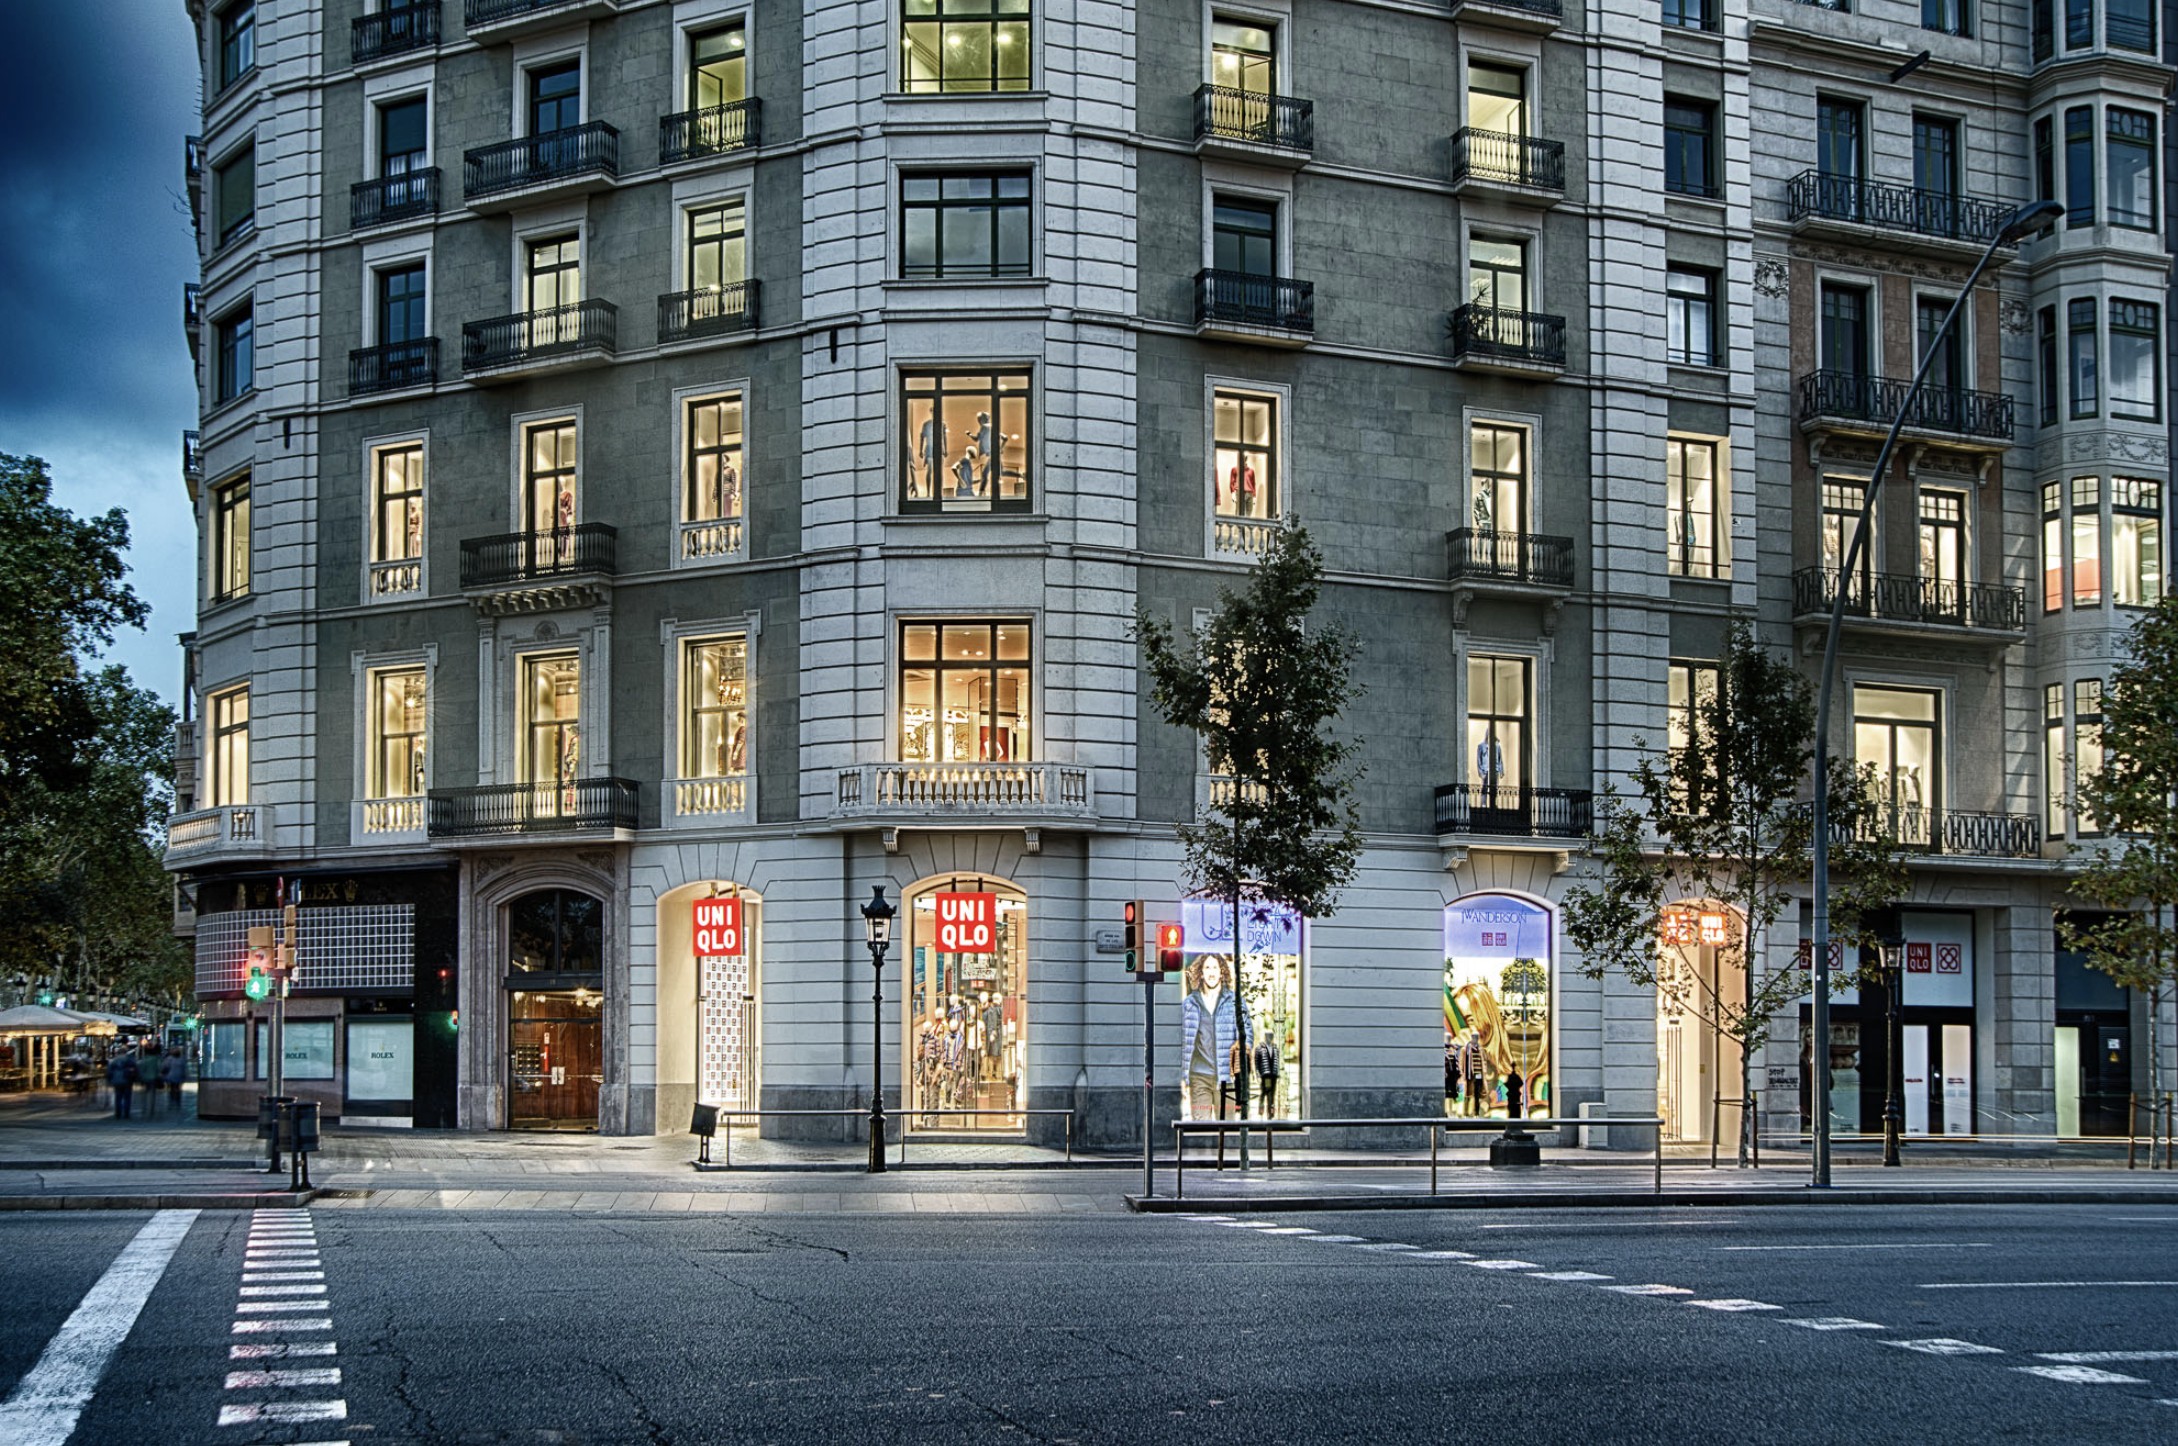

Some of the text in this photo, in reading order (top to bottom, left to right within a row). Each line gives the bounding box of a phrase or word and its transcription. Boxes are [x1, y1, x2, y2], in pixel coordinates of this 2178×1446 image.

[697, 905, 732, 926] UNI
[942, 899, 984, 921] UNI
[1701, 915, 1722, 928] UNI
[697, 929, 736, 953] QLO
[942, 924, 989, 949] QLO
[1247, 931, 1282, 942] DOWN
[1701, 929, 1724, 944] QLO
[1910, 946, 1927, 957] UNI
[1910, 959, 1929, 970] QLO
